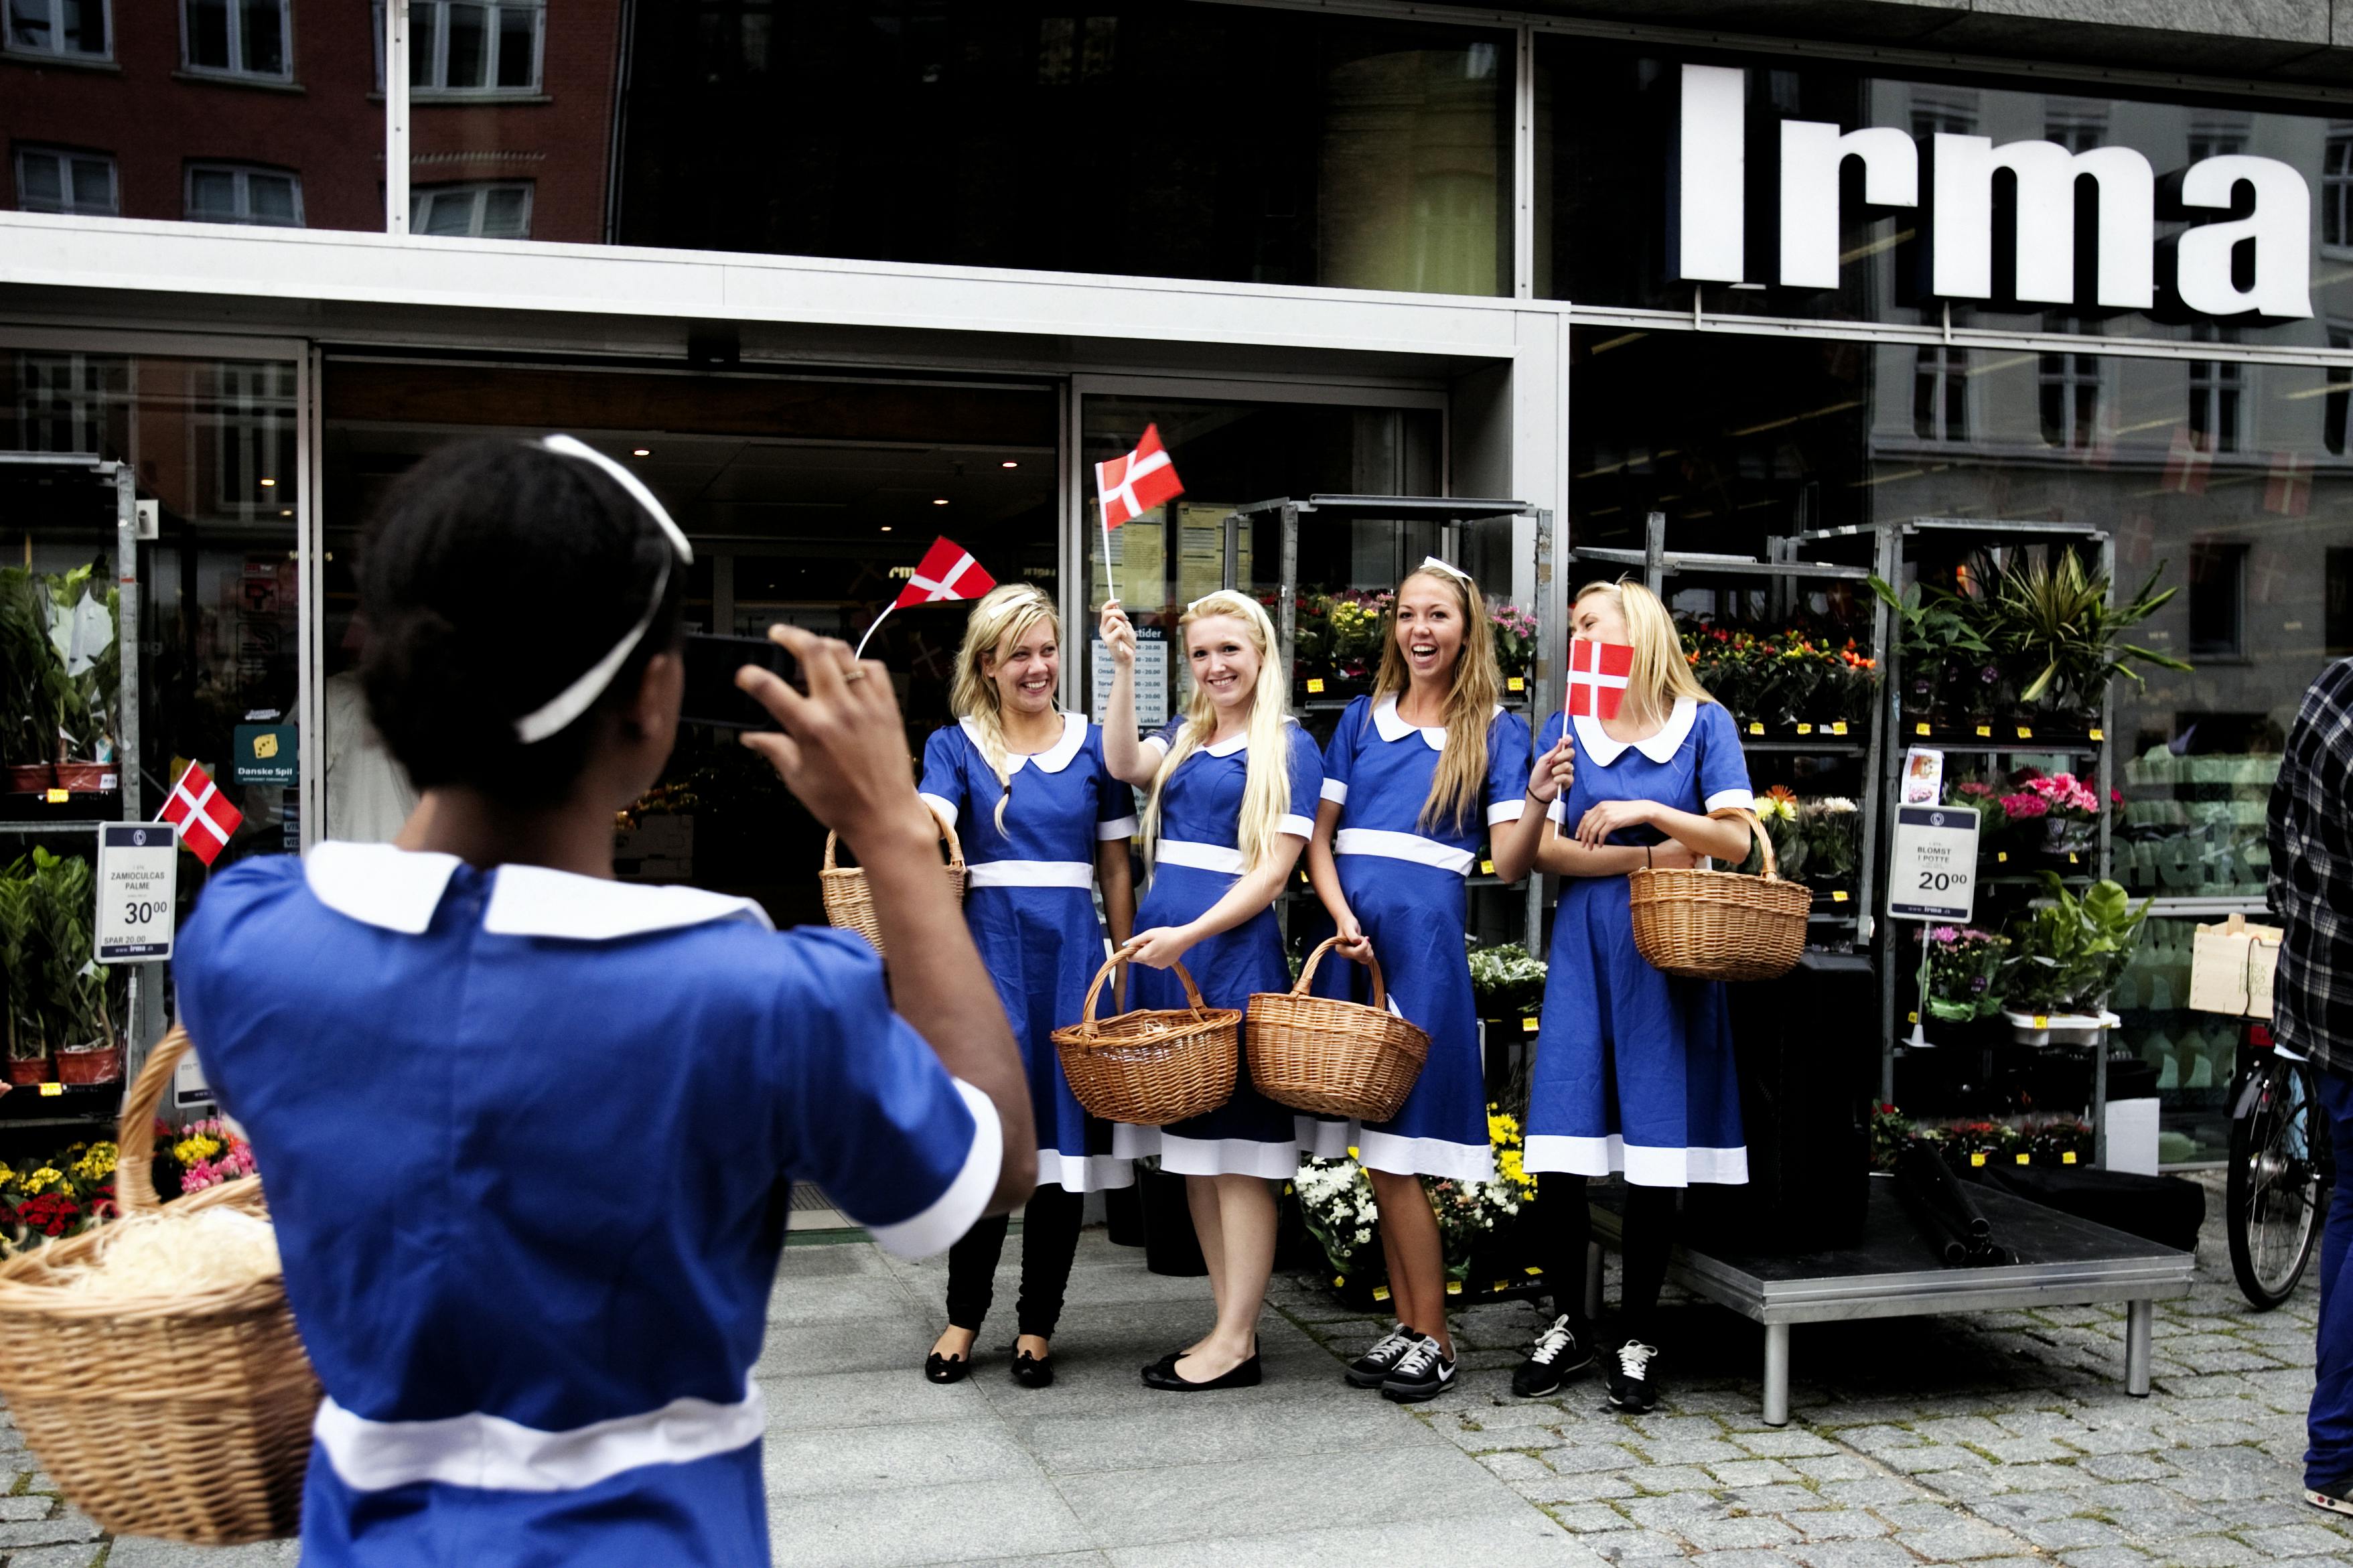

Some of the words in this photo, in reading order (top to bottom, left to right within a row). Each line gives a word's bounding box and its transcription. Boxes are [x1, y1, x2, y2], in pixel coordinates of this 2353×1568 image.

[1680, 64, 2314, 318] Irma
[238, 767, 273, 775] Danske
[275, 768, 293, 777] Spil
[1917, 846, 1952, 855] BLOMST
[1923, 855, 1950, 863] POTTE
[111, 871, 165, 881] ZAMIOCULCAS
[1918, 871, 1949, 891] 20
[1951, 873, 1967, 884] 00
[125, 882, 150, 890] PALME
[125, 902, 152, 924] 30
[153, 902, 167, 913] 00
[125, 935, 146, 944] 20.00
